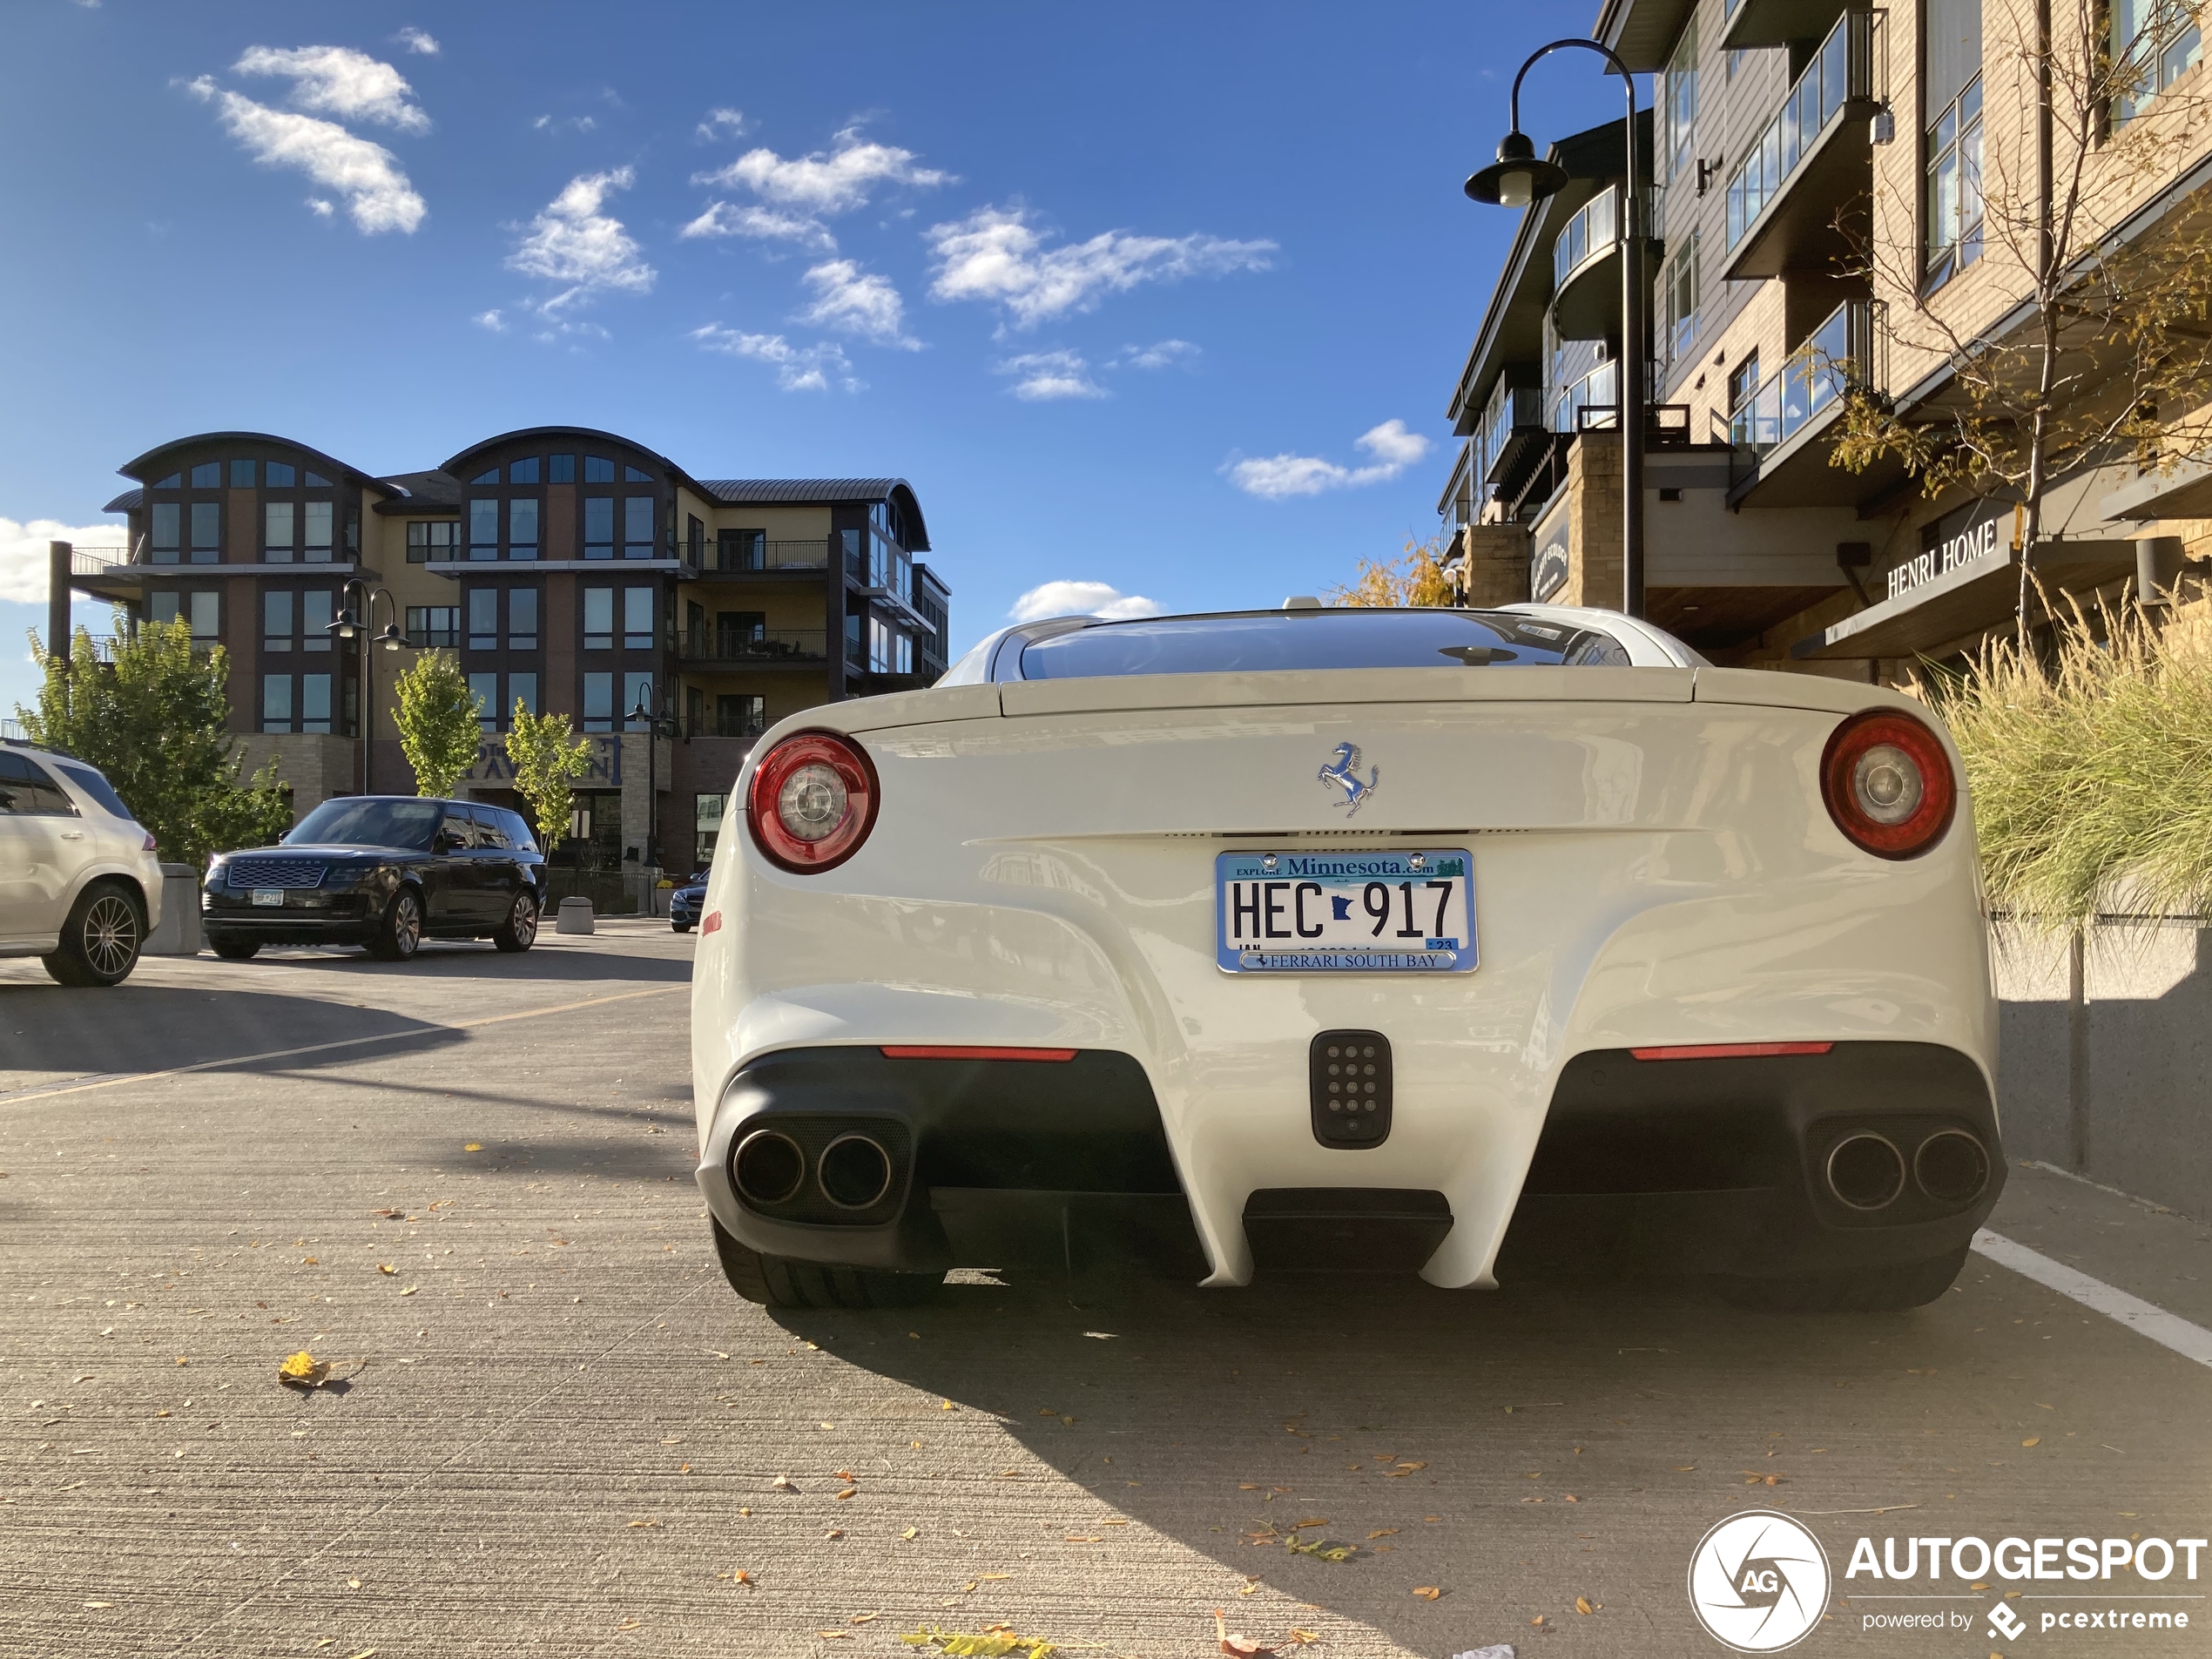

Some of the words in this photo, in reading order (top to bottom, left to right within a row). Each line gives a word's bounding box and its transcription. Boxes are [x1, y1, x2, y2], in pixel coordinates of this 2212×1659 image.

[1887, 549, 1936, 600] HENRI
[1942, 520, 1995, 574] HOME
[486, 743, 508, 757] TH
[1233, 882, 1323, 938] HEC
[1363, 881, 1453, 938] 917
[1436, 941, 1453, 950] 23
[1271, 954, 1339, 968] FERRARI
[1345, 954, 1399, 968] SOUTH
[1406, 954, 1439, 967] BAY
